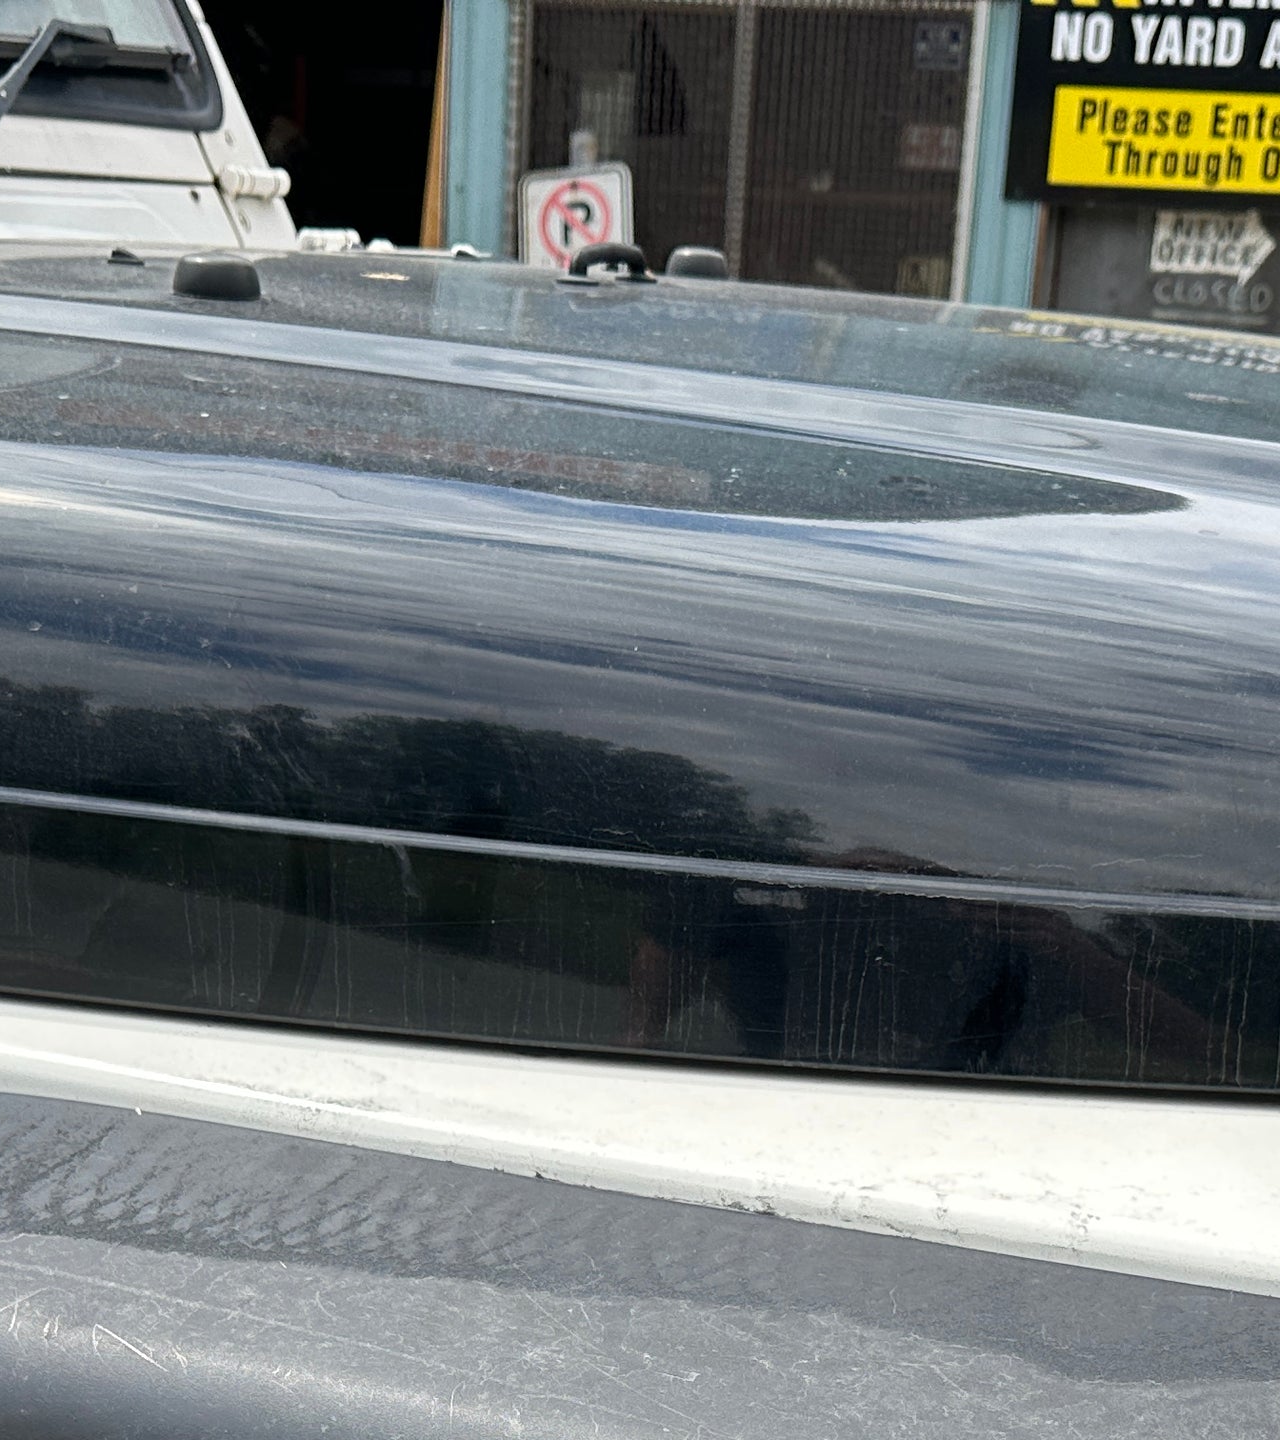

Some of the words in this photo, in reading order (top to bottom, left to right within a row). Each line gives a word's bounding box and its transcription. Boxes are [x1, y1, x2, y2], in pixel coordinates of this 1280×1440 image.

[1051, 12, 1114, 63] NO
[1131, 14, 1246, 67] YARD
[1076, 98, 1192, 136] Please
[1104, 140, 1242, 184] Through
